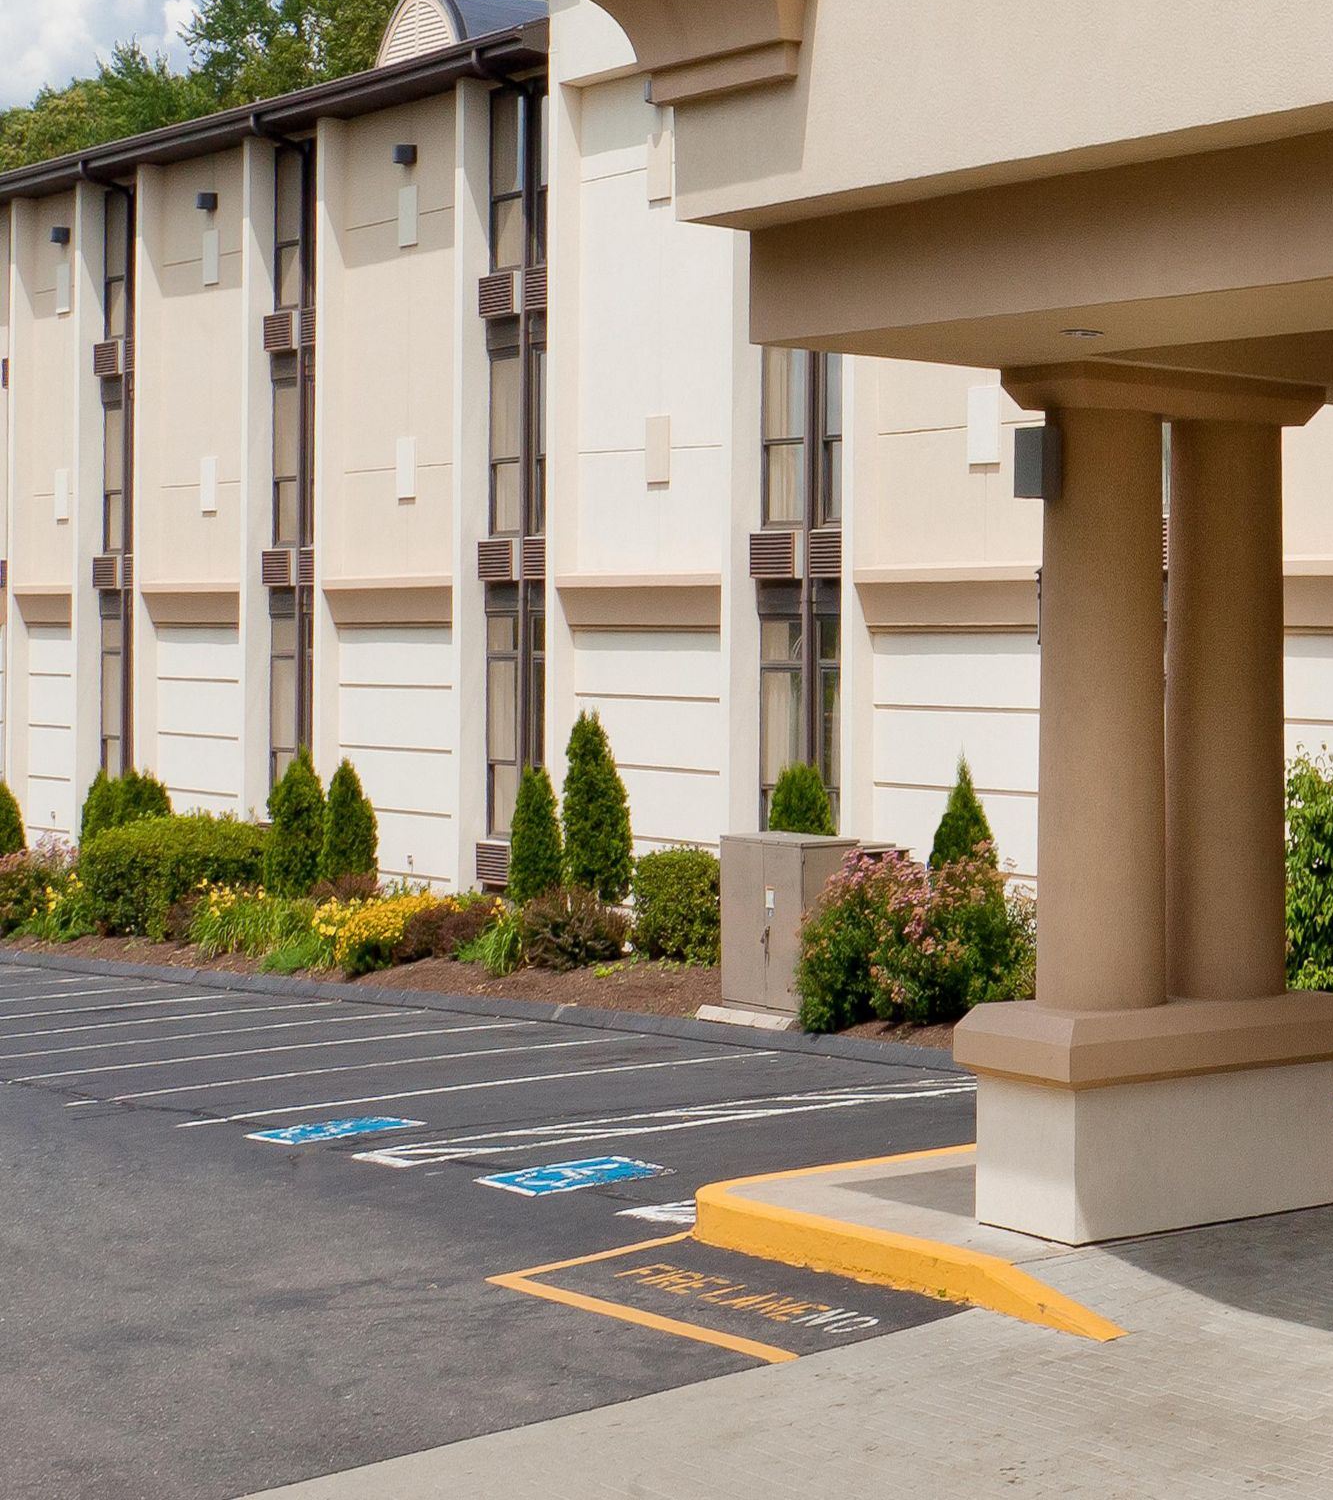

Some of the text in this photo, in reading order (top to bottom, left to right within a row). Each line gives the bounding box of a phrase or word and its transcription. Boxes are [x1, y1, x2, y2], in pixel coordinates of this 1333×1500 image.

[614, 1263, 880, 1334] FIRE LANE NO
